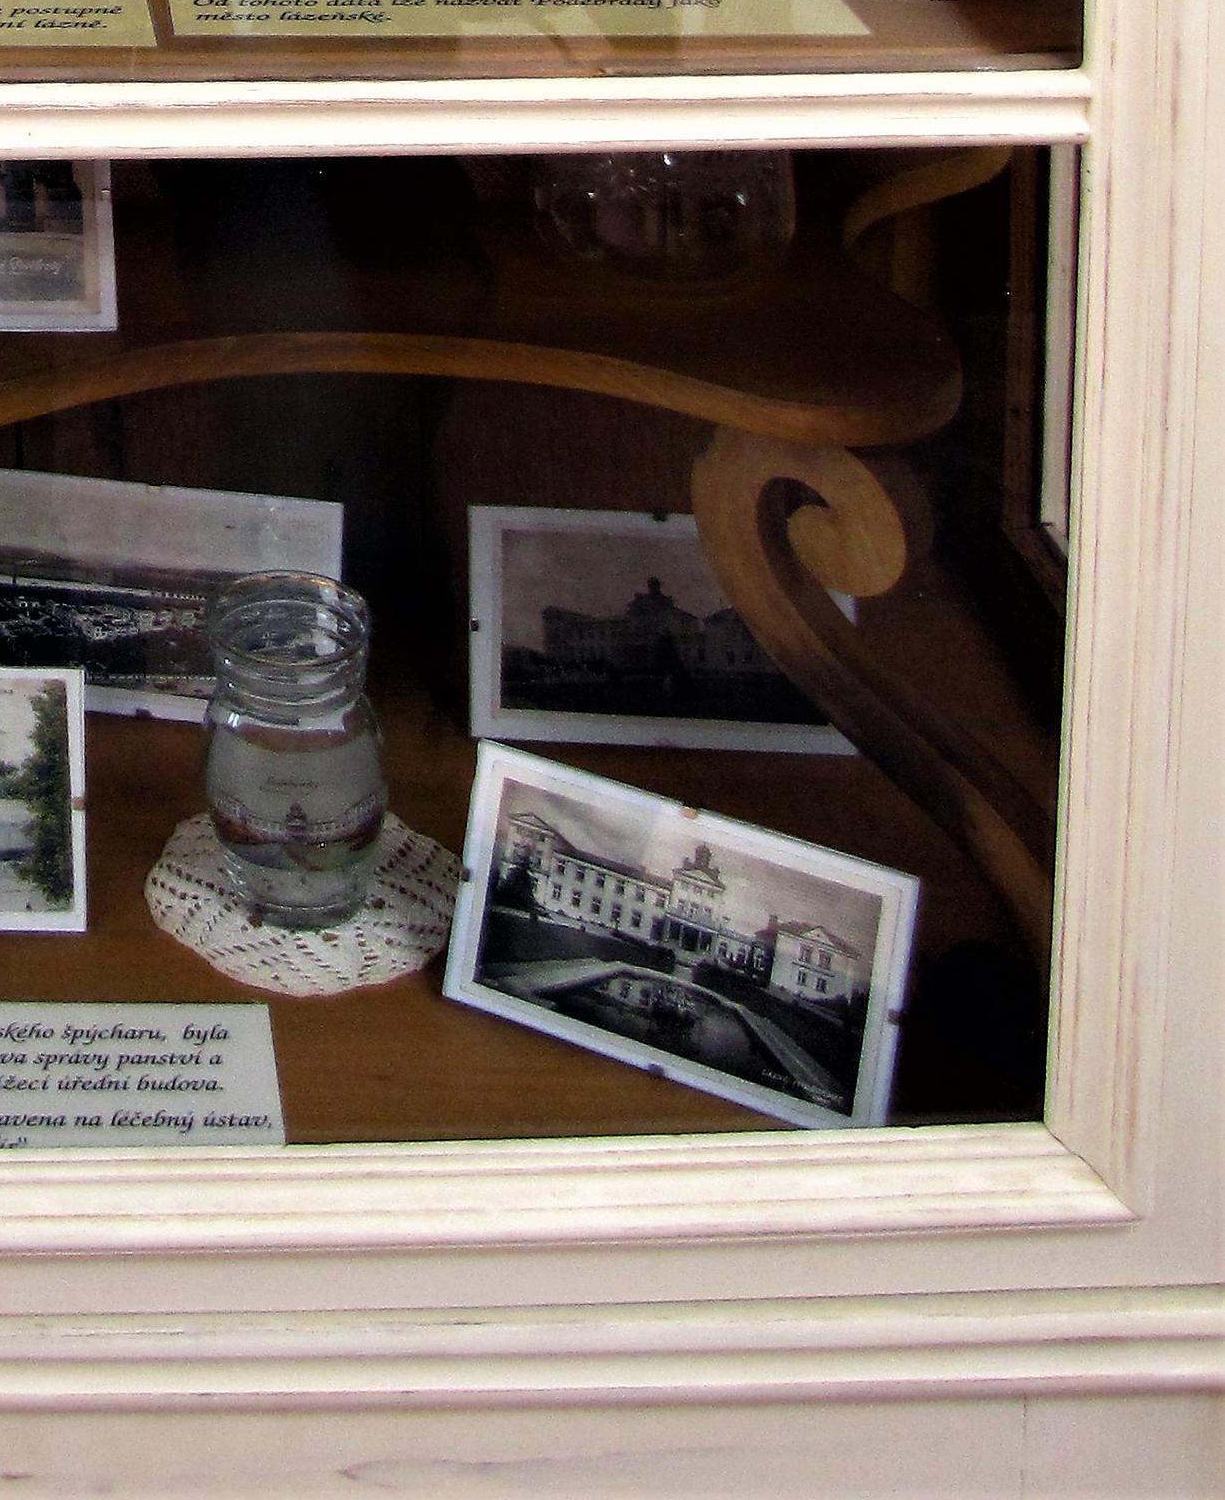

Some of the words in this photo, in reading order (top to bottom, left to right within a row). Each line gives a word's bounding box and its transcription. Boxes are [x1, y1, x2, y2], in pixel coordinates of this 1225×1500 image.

[9, 6, 122, 17] postupně
[196, 11, 270, 21] město
[34, 19, 107, 29] lázně.
[61, 1023, 167, 1045] špýcharu,
[183, 1023, 229, 1045] byla
[32, 1050, 110, 1070] správy
[117, 1049, 201, 1070] panství
[209, 1055, 223, 1065] a
[57, 1074, 130, 1091] úřední
[136, 1075, 224, 1092] budova.
[74, 1114, 102, 1128] na
[110, 1110, 195, 1134] léčebný
[203, 1111, 273, 1130] ústav,
